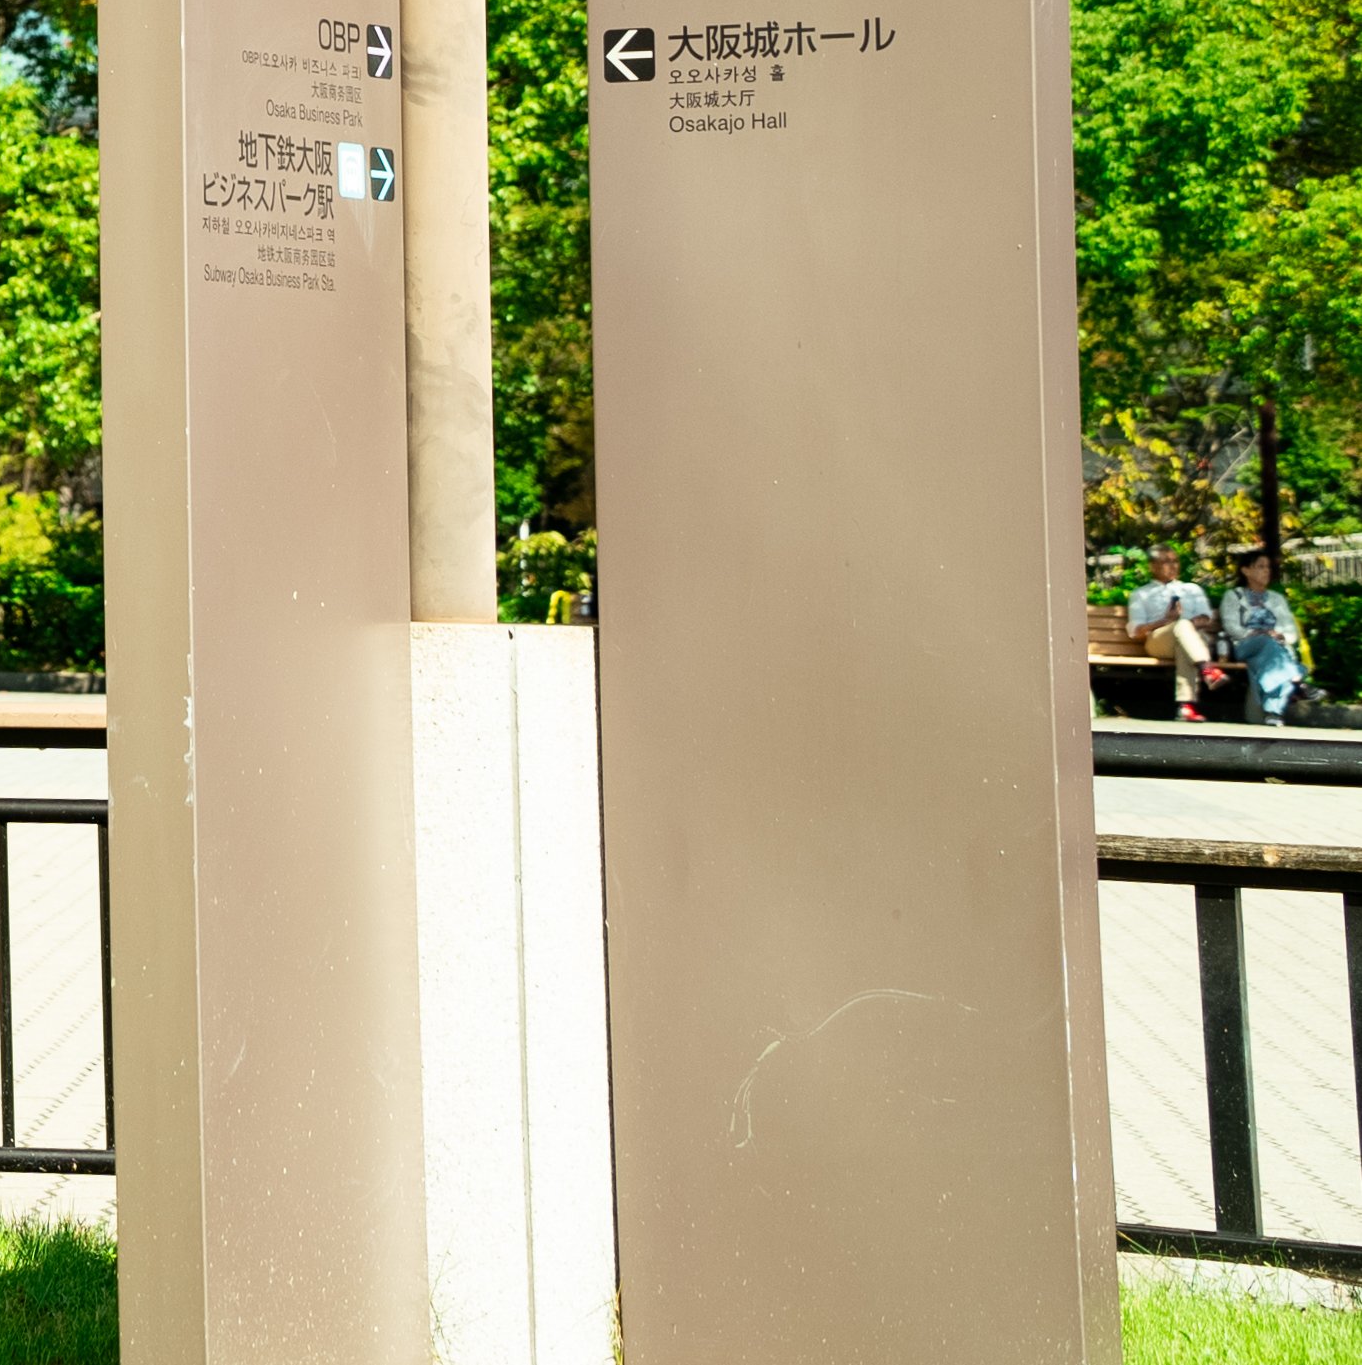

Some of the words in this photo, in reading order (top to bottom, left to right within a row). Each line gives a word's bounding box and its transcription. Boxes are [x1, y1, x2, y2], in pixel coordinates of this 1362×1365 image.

[318, 18, 360, 54] OBP
[668, 17, 896, 63] 大阪城ホール
[302, 58, 337, 77] 비즈니스
[342, 64, 362, 81] 파크)
[668, 66, 757, 85] 오오사카성
[769, 64, 786, 82] 홀
[311, 80, 363, 104] 大阪商务园区
[669, 89, 755, 110] 大阪城大厅
[266, 99, 296, 120] Osaka
[299, 103, 341, 125] Business
[343, 109, 363, 128] Park
[669, 114, 745, 134] Osakajo
[751, 112, 787, 129] Hall
[238, 130, 333, 177] 地下鉄大阪
[203, 171, 335, 220] ビジネスパーク駅
[202, 215, 230, 235] 지하철
[327, 228, 335, 244] 역
[204, 263, 237, 288] Subway
[238, 266, 265, 286] Osaka
[266, 269, 301, 289] Business
[302, 272, 319, 291] Park
[321, 274, 336, 292] Sta.
